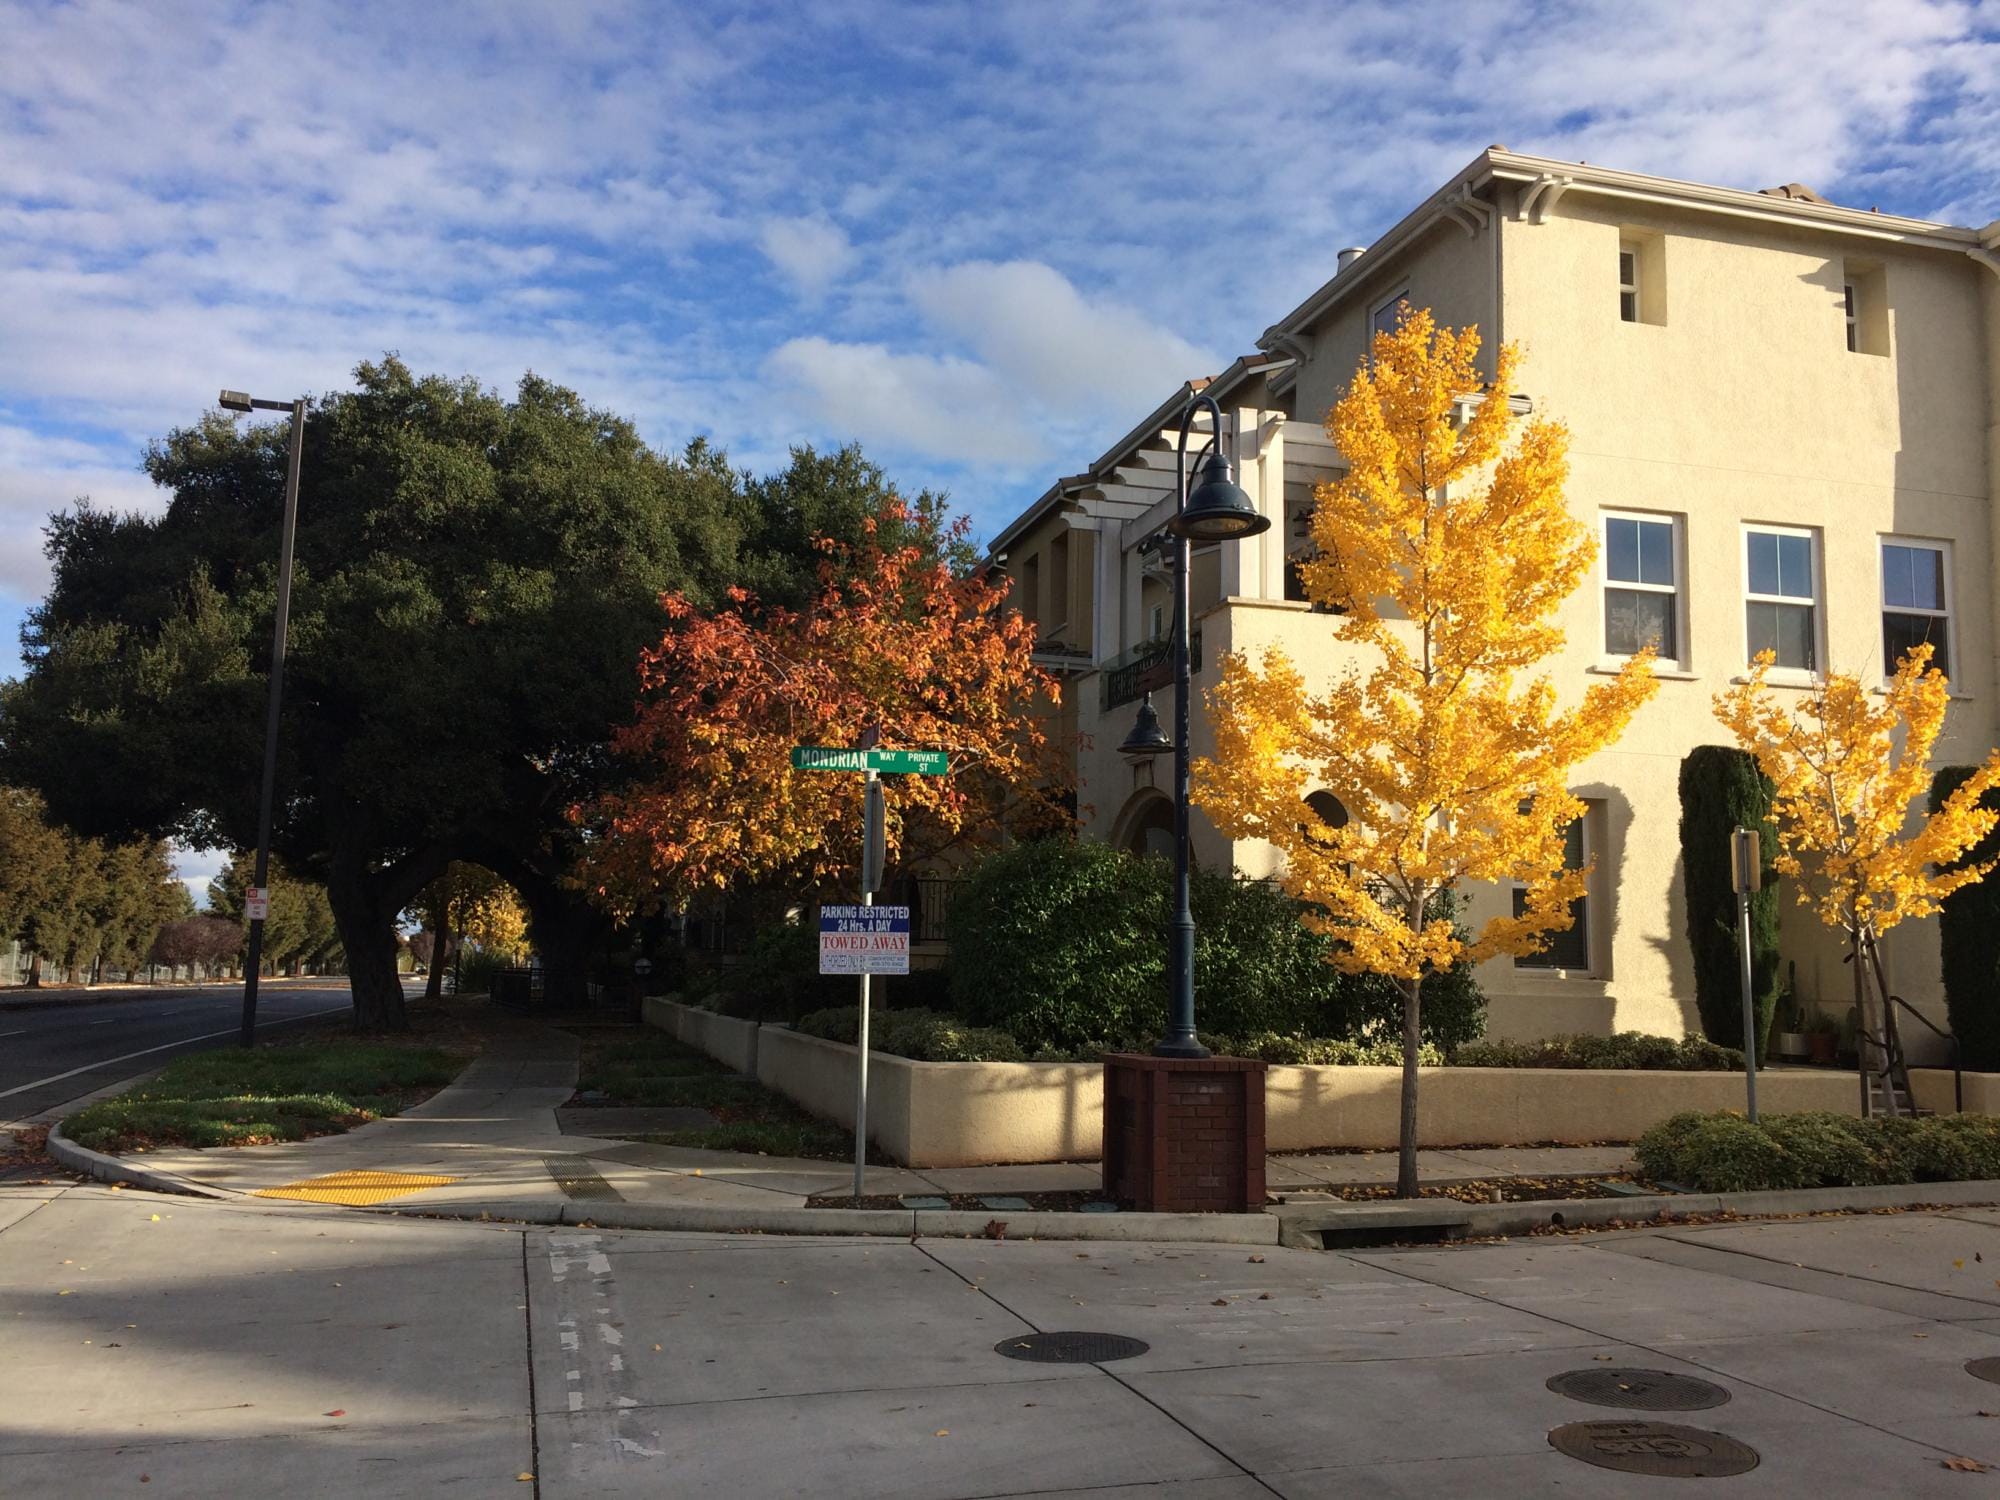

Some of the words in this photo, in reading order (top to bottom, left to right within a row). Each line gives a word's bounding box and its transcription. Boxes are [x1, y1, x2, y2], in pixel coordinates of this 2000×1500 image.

[801, 749, 868, 768] MONDRIAN
[879, 752, 896, 761] WAY
[907, 753, 940, 763] PRIVATE
[918, 762, 928, 772] ST
[821, 906, 857, 919] PARKING
[858, 906, 910, 919] RESTRICTED
[838, 919, 848, 931] 24
[867, 920, 874, 932] A
[876, 920, 892, 932] DAY
[821, 936, 869, 949] TOWED
[871, 936, 908, 950] AWAY
